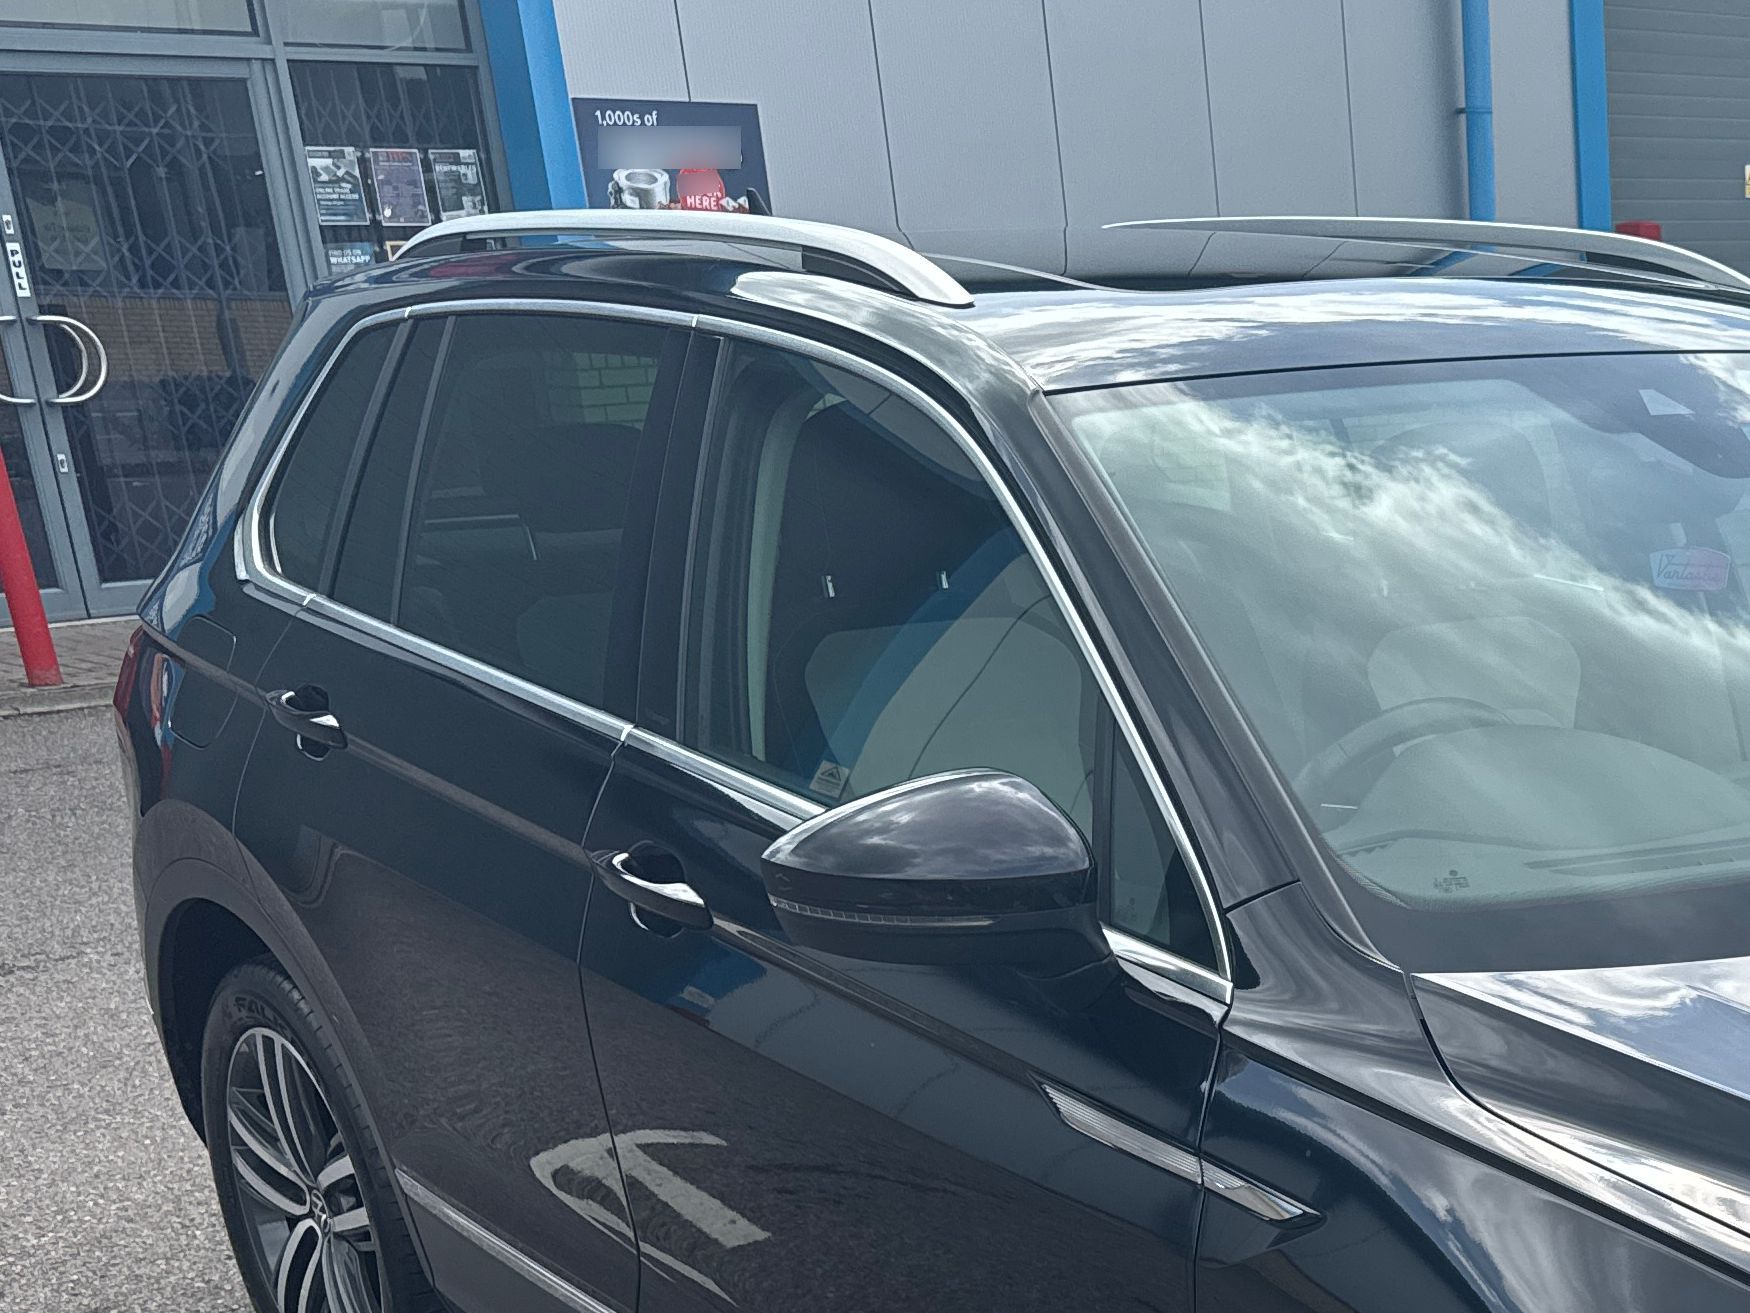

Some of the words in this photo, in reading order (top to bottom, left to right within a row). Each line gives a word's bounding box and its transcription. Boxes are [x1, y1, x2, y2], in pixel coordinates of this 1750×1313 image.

[595, 110, 641, 126] 1,000s
[644, 110, 658, 127] of
[686, 195, 718, 210] HERE
[330, 256, 370, 265] WHATSAPP
[10, 249, 27, 291] PULL
